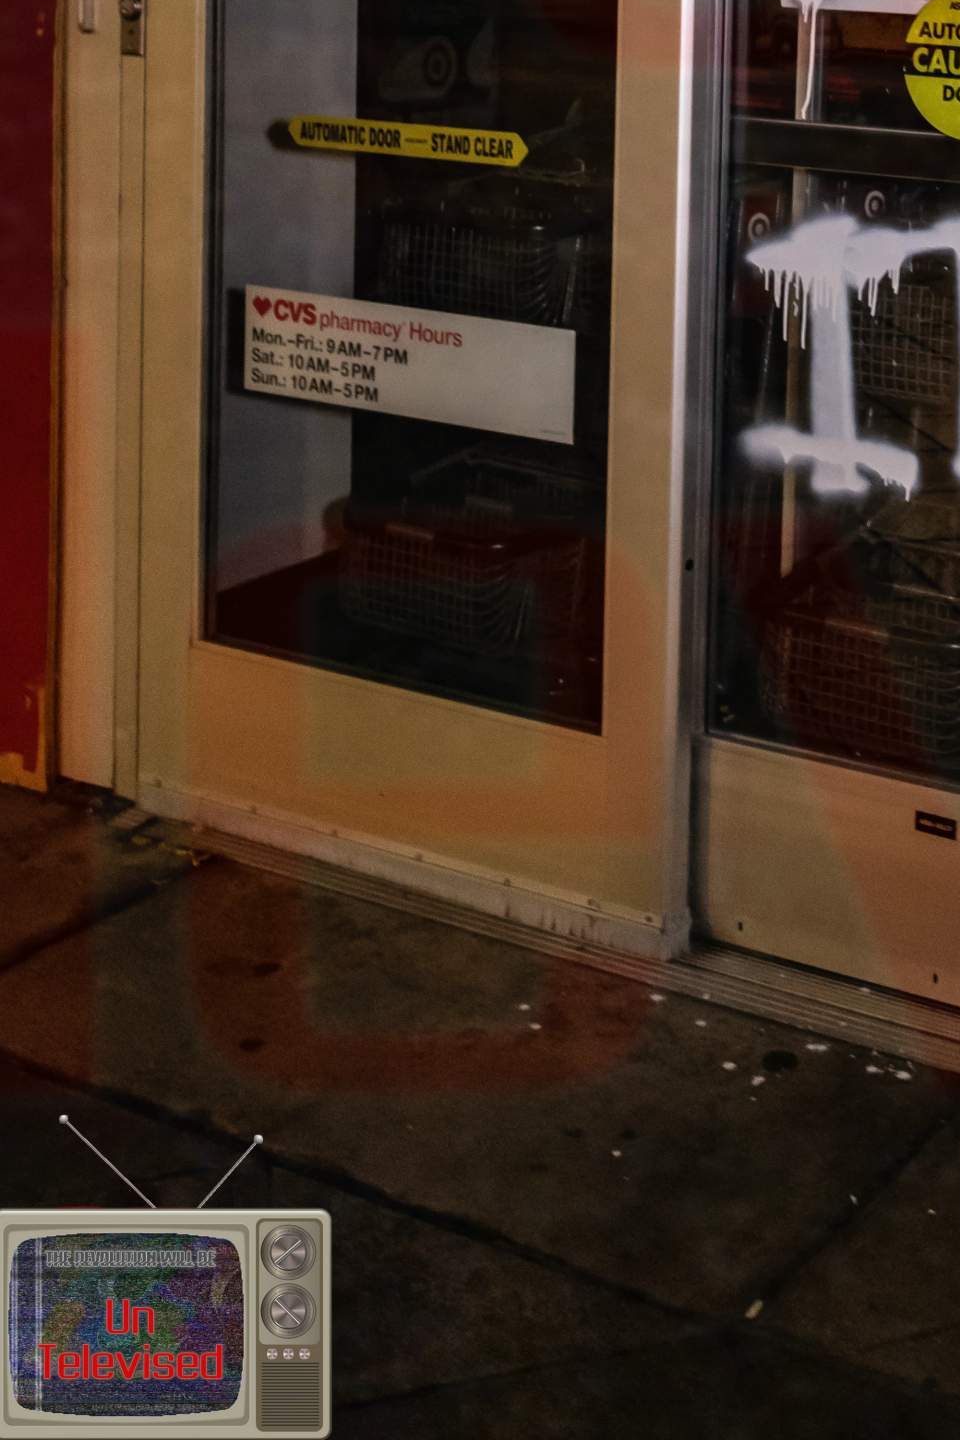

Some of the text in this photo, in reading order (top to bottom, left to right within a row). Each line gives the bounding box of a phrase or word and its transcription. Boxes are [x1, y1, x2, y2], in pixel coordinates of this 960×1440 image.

[300, 122, 514, 160] AUTOMATIC DOOR STAND CLEAR
[273, 298, 463, 347] CVS pharmacy Hours
